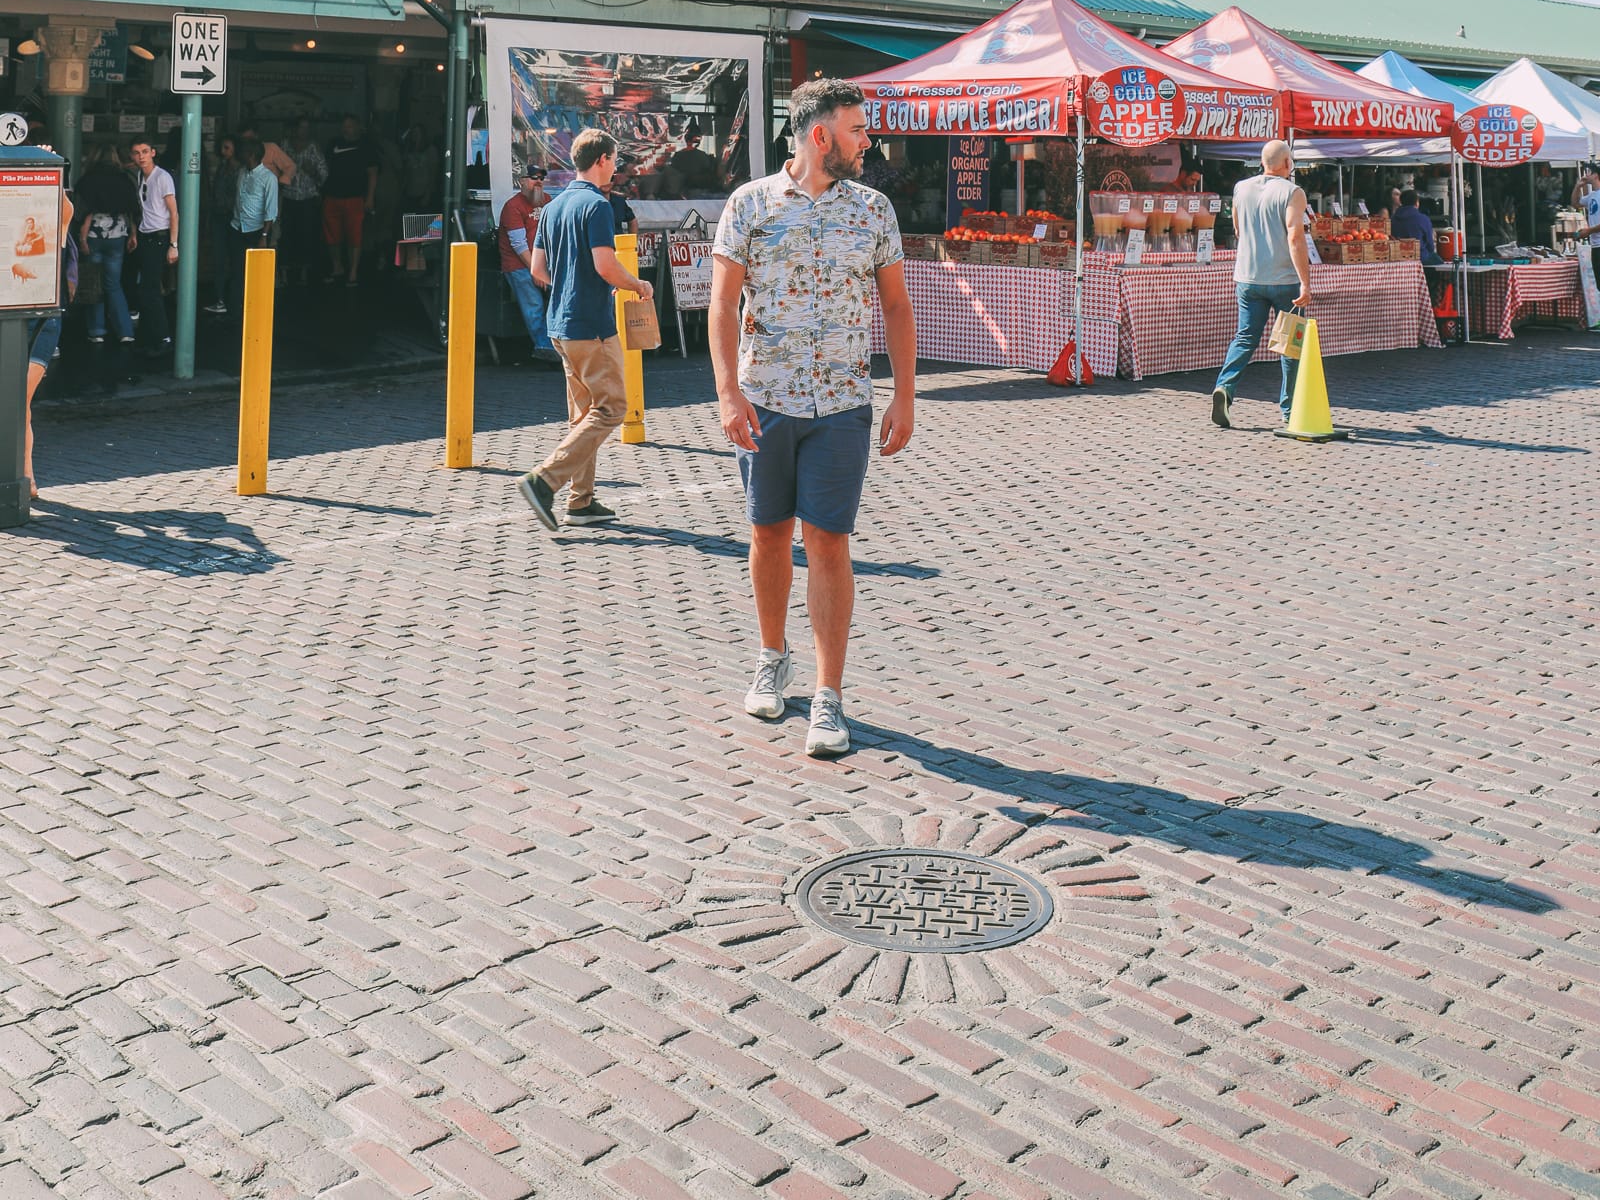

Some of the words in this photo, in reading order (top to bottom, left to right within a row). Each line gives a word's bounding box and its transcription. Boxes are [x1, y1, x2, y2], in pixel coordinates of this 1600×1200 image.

[180, 21, 219, 40] ONE
[180, 43, 220, 61] WAY
[1121, 68, 1147, 84] ICE
[877, 85, 906, 97] Cold
[908, 83, 963, 97] Pressed
[966, 83, 1022, 98] Organic
[1113, 84, 1156, 102] COLD
[1183, 90, 1218, 104] essed
[1224, 91, 1273, 108] Organic
[864, 100, 882, 131] CE
[886, 100, 930, 132] COLD
[935, 99, 990, 131] APPLE
[996, 96, 1060, 132] CIDER!
[1098, 102, 1174, 121] APPLE
[1311, 100, 1365, 127] TINY'S
[1367, 101, 1442, 133] ORGANIC
[1488, 105, 1512, 118] ICE
[1098, 121, 1175, 138] CIDER
[1196, 105, 1239, 137] APPLE
[1238, 107, 1279, 139] CIDER!
[1478, 117, 1519, 132] COLD
[1463, 133, 1534, 147] APPLE
[1462, 147, 1533, 161] CIDER
[951, 156, 989, 170] ORGANIC
[957, 171, 982, 185] APPLE
[957, 186, 982, 201] CIDER
[672, 246, 688, 262] NO
[674, 271, 689, 279] FROM
[854, 887, 997, 911] WATER
